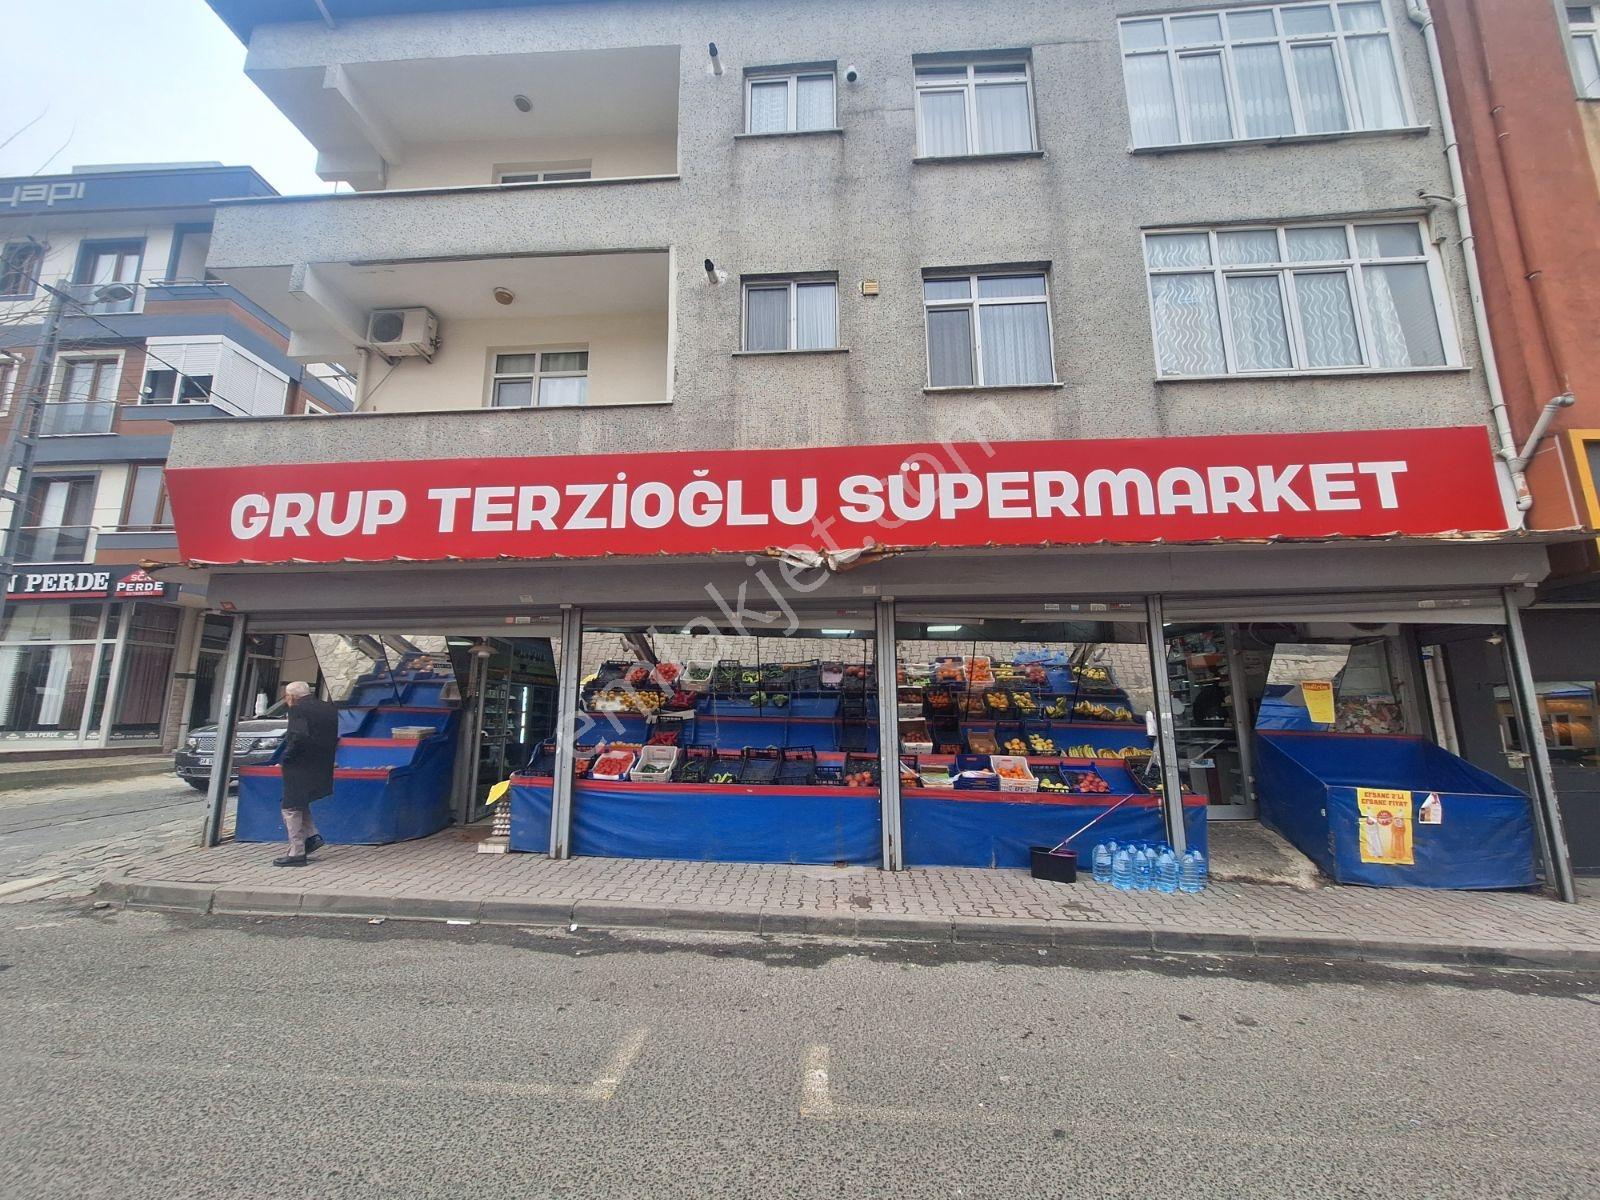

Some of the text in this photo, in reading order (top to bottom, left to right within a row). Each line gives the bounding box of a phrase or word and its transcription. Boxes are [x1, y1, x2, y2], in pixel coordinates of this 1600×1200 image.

[231, 461, 1407, 539] GRUP TERZİOĞLU SÜPERMARKET
[24, 572, 110, 592] PERDE
[116, 581, 164, 592] PERDE
